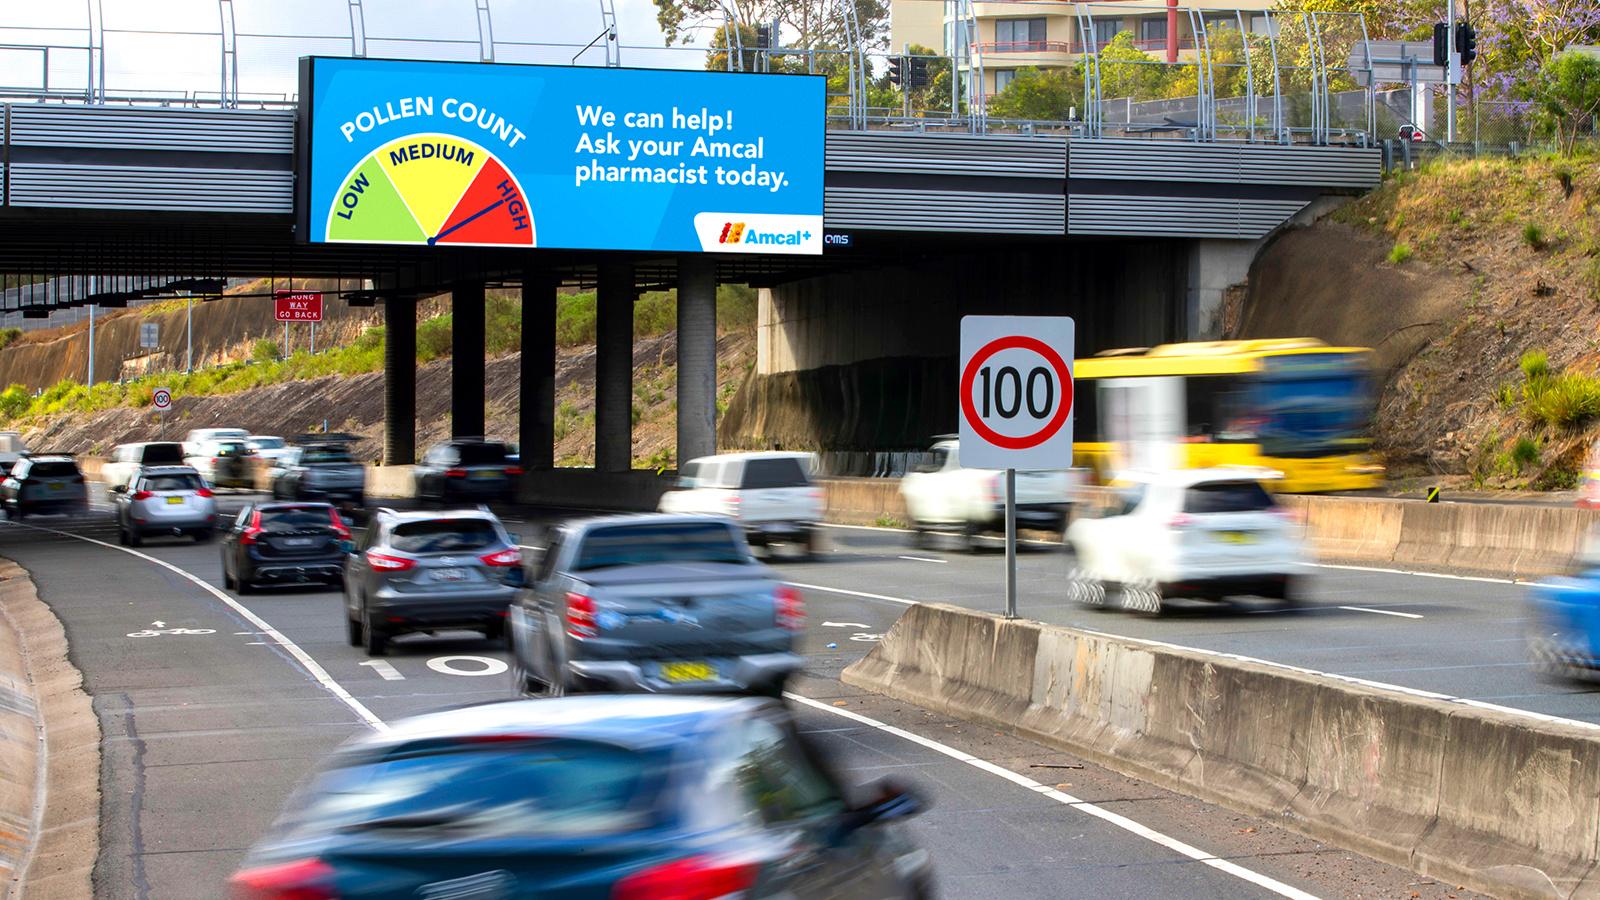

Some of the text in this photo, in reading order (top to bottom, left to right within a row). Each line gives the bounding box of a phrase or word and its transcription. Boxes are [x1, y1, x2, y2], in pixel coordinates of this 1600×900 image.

[340, 97, 526, 147] POLLEN COUNT
[576, 105, 732, 136] We can help!
[389, 143, 474, 166] MEDIUM
[575, 132, 763, 161] Ask your Amcal
[575, 159, 788, 192] pharmacist today.
[337, 172, 370, 220] LOW
[496, 179, 528, 231] HIGH
[156, 394, 169, 403] 100
[980, 366, 1053, 419] 100
